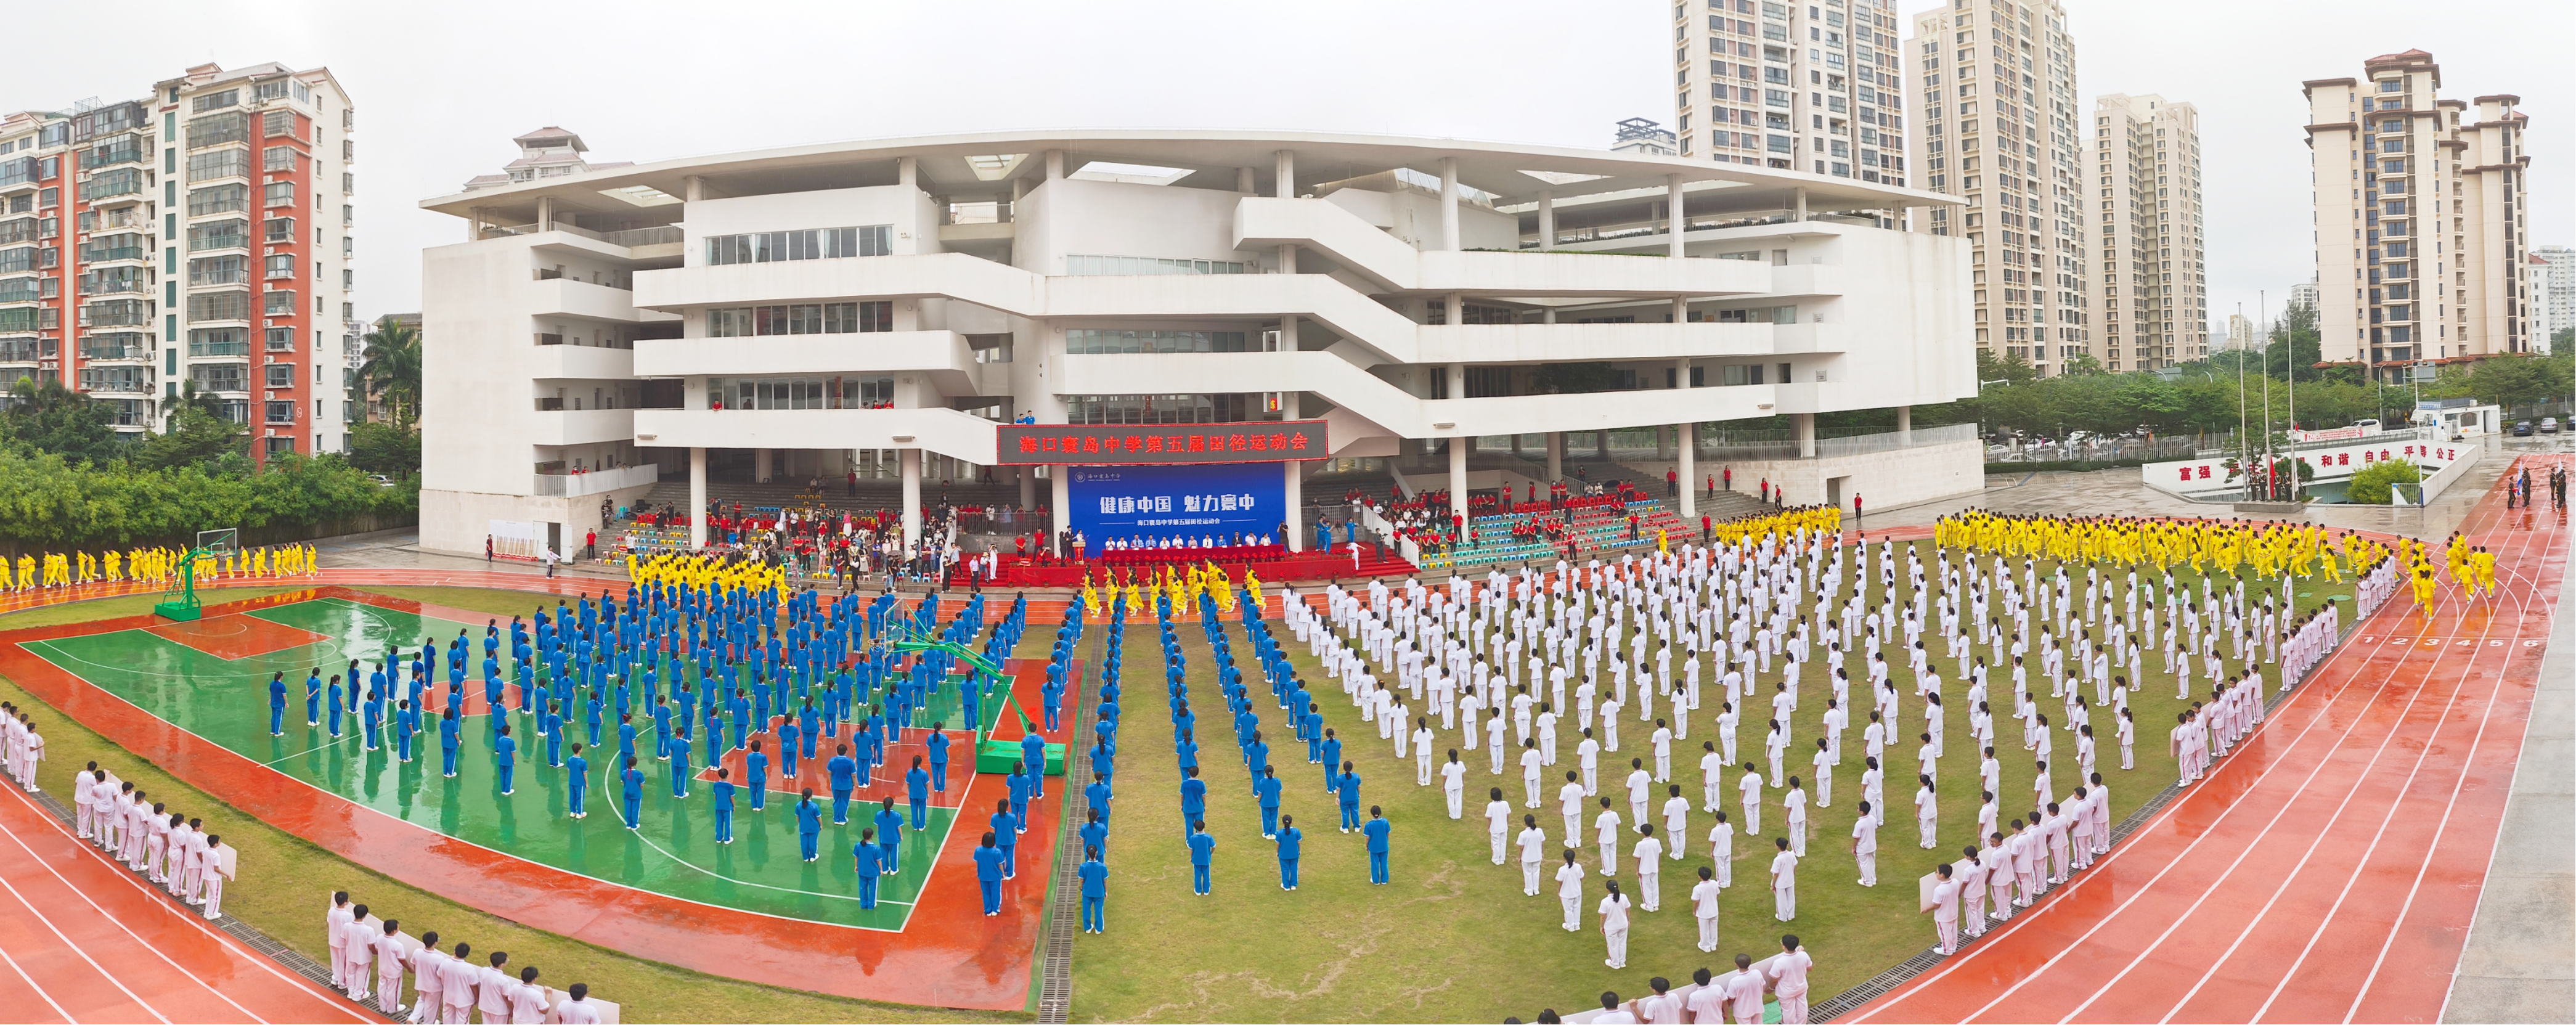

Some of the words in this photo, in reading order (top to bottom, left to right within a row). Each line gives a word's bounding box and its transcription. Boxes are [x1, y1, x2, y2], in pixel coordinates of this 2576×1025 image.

[1019, 431, 1308, 454] 海口寰岛中学第五届田径运动会
[2179, 465, 2211, 481] 富强
[2321, 452, 2349, 468] 和谐
[2365, 449, 2390, 463] 自由
[2404, 445, 2427, 458] 平等
[2436, 447, 2455, 461] 公正
[1100, 496, 1172, 514] 健康中国
[1184, 494, 1255, 512] 魅力寰中
[1137, 518, 1220, 526] 海口寰岛中学第五届田径运动会
